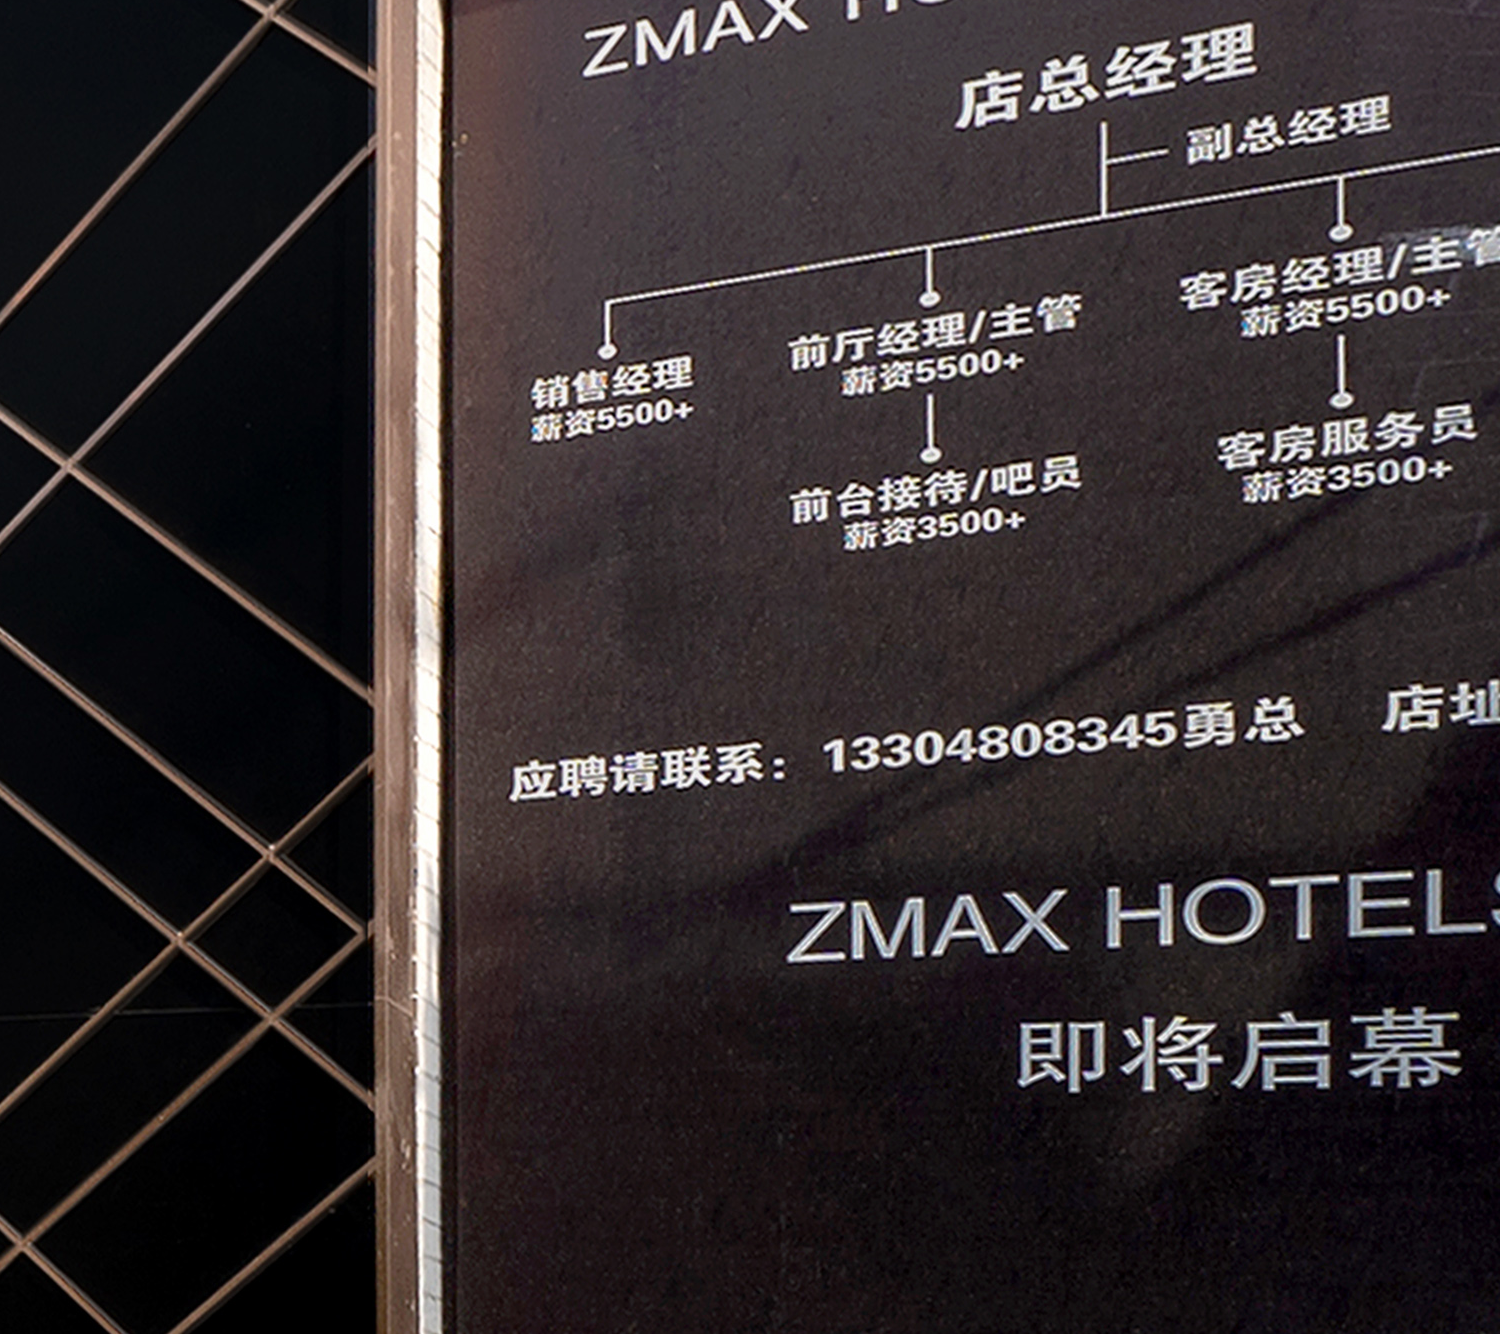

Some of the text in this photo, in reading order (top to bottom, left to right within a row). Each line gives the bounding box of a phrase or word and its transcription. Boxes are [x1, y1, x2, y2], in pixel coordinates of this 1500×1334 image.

[956, 22, 1257, 129] 店总经理
[1187, 95, 1391, 164] 副总经理
[788, 293, 1082, 371] 前厅经理/主管
[1240, 284, 1451, 338] 薪资5500+
[531, 355, 694, 411] 销售经理
[841, 348, 1025, 397] 薪资5500+
[531, 398, 695, 443] 薪资5500+
[1217, 403, 1478, 471] 客房服务员
[789, 455, 1082, 525] 前台接待/吧员
[1242, 456, 1453, 504] 薪资3500+
[844, 506, 1026, 551] 薪资3500+
[822, 695, 1305, 773] 13304808345勇总
[786, 868, 1500, 963] ZMAX HOTEL
[1017, 1006, 1462, 1093] 即将启幕
